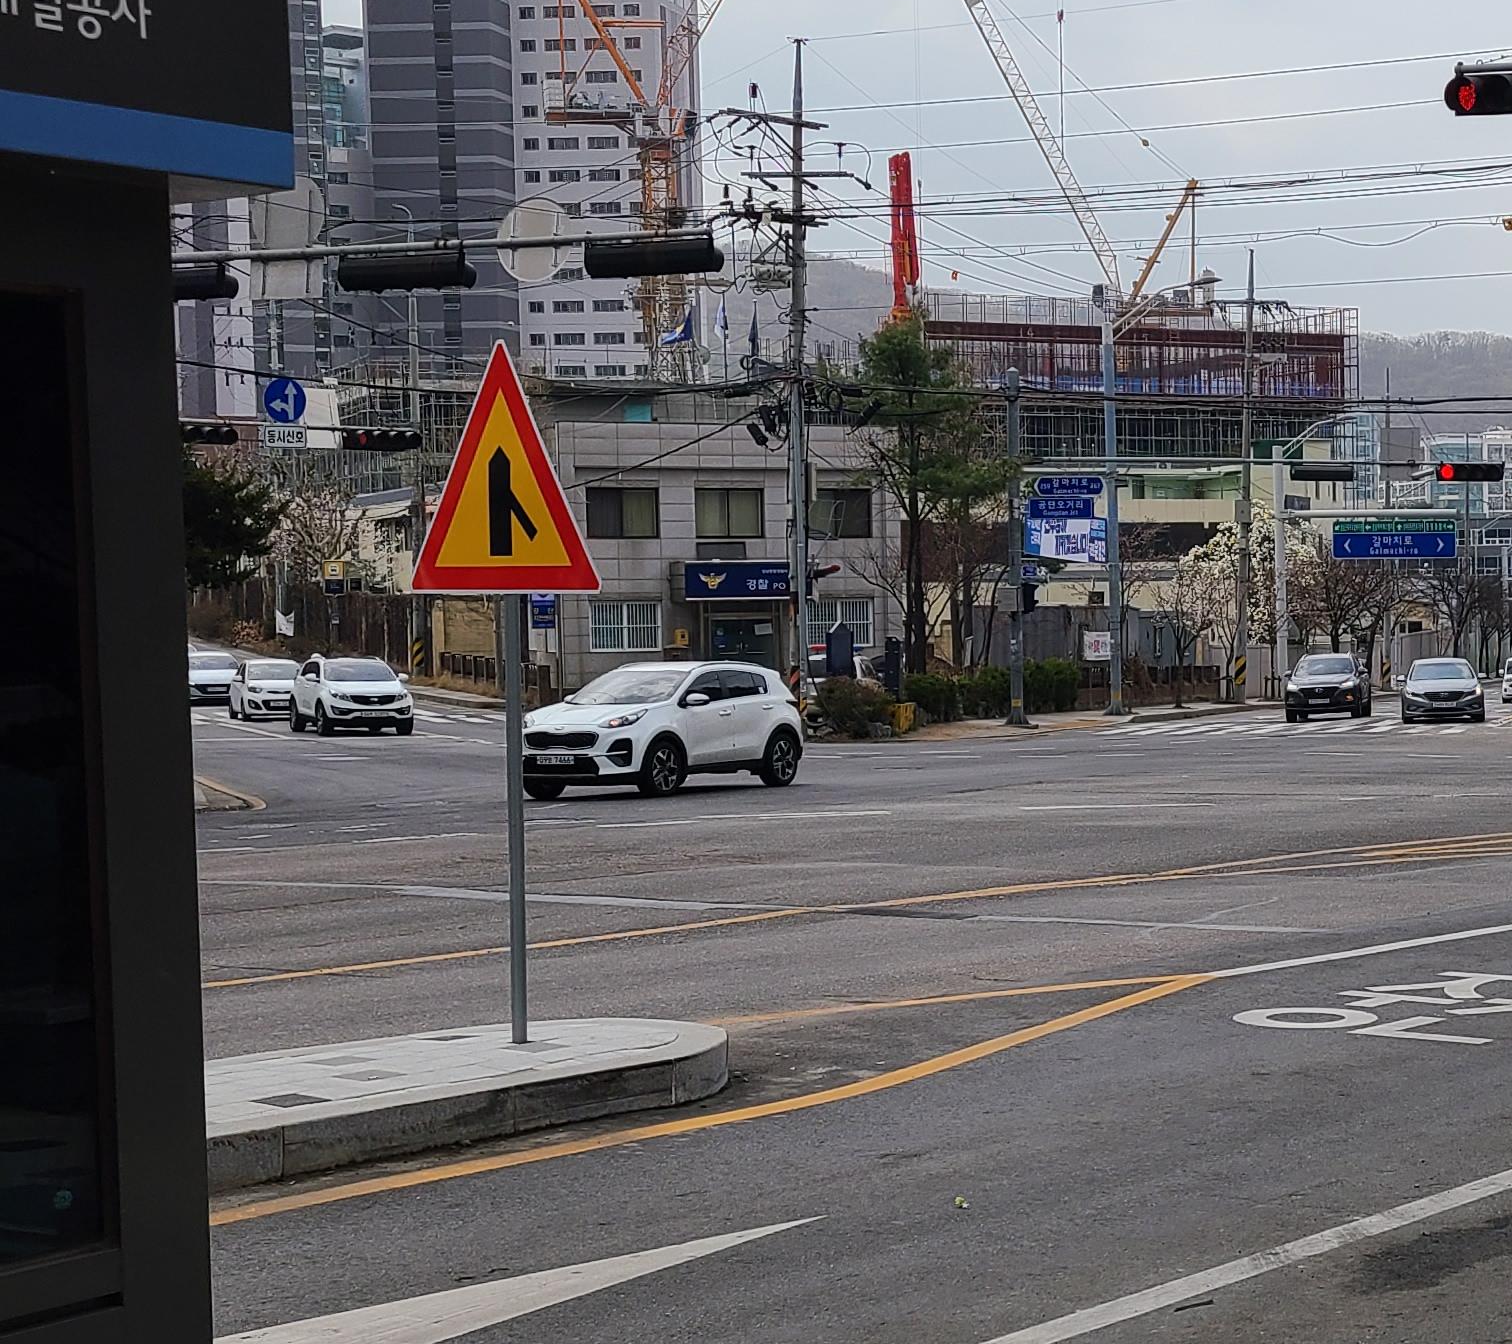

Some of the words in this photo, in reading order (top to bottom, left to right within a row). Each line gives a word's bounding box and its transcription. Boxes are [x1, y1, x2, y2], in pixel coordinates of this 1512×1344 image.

[266, 429, 304, 446] 동시신호
[1037, 500, 1084, 509] 공단오거리
[1371, 535, 1414, 548] 갈마치로
[746, 578, 769, 591] 경찰
